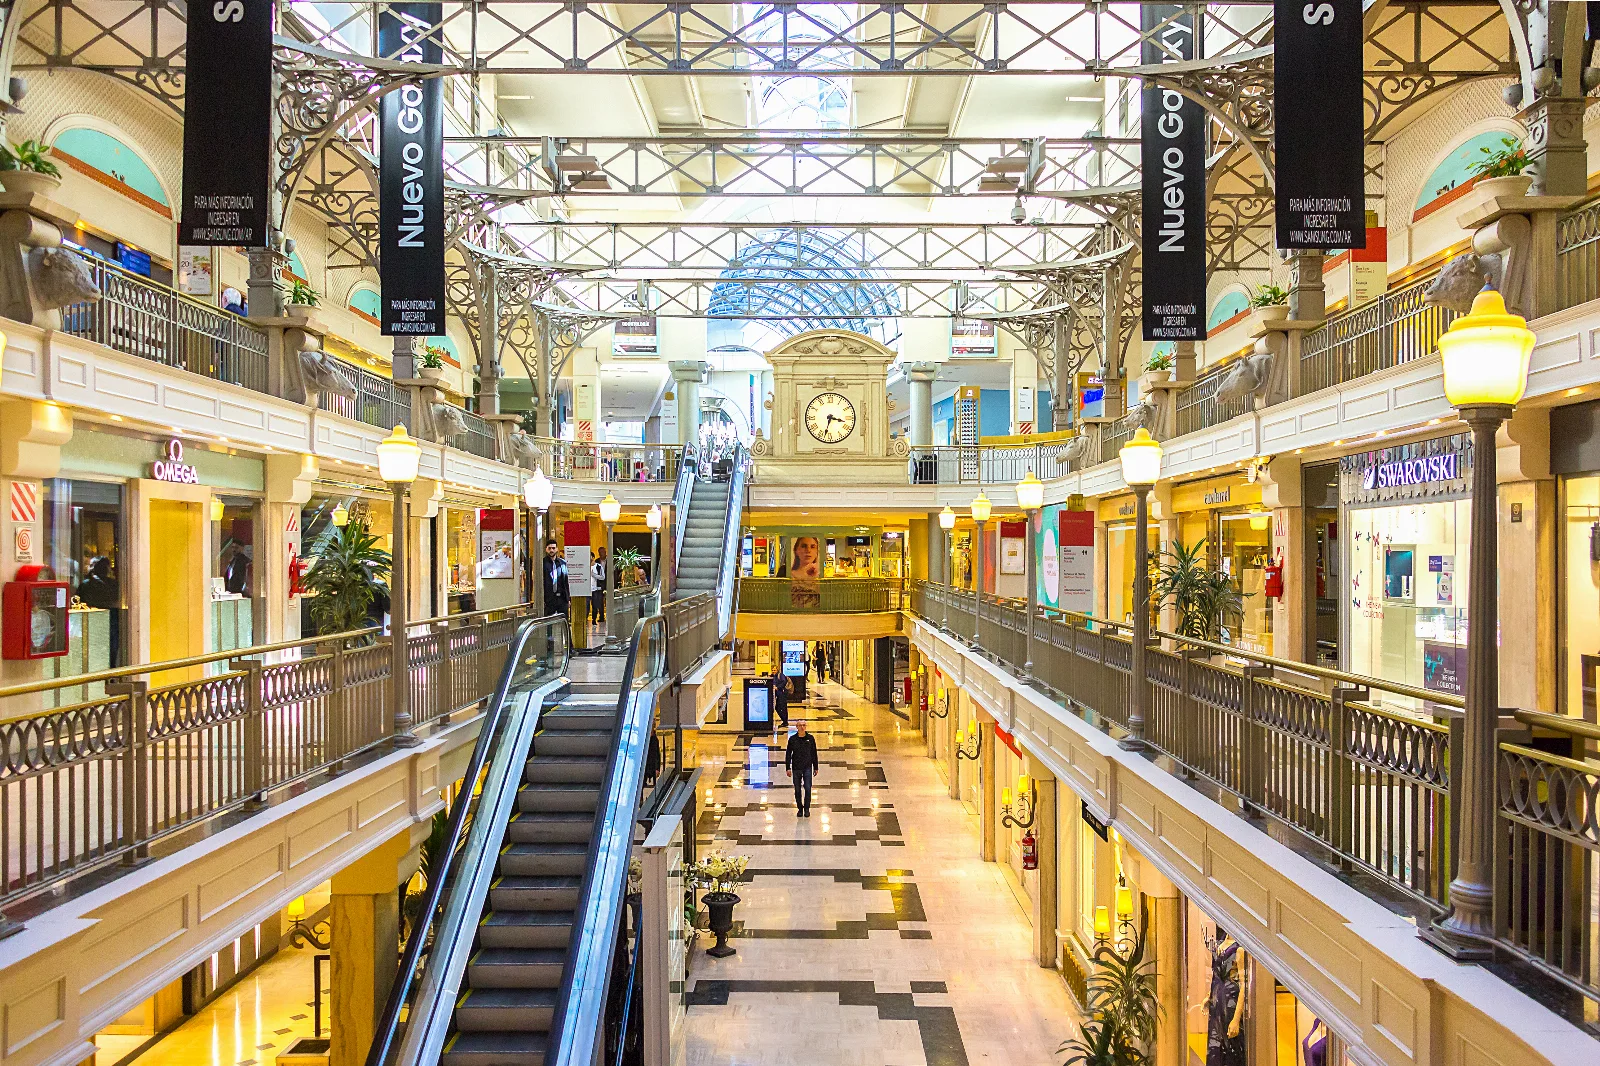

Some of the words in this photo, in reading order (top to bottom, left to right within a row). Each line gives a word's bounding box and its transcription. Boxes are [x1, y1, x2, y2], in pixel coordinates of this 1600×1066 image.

[397, 12, 431, 134] Gaxy
[1157, 17, 1192, 139] Gaxy
[194, 195, 207, 209] PARA
[208, 192, 219, 209] MÁS
[220, 192, 254, 209] INFORMACIÓN
[397, 142, 424, 248] Nuevo
[1158, 147, 1185, 252] Nuevo
[1289, 198, 1303, 212] PARA
[1303, 195, 1315, 212] MÁS
[1316, 196, 1351, 212] INFORMACIÓN
[207, 211, 232, 226] INGRESAR
[232, 211, 240, 226] EN
[1303, 214, 1329, 228] INGRESAR
[1329, 214, 1337, 228] EN
[1289, 230, 1352, 243] WWW.SAMSUNG.COM/AR
[154, 460, 199, 484] OMEGA
[1378, 453, 1457, 488] SWAROVSKI
